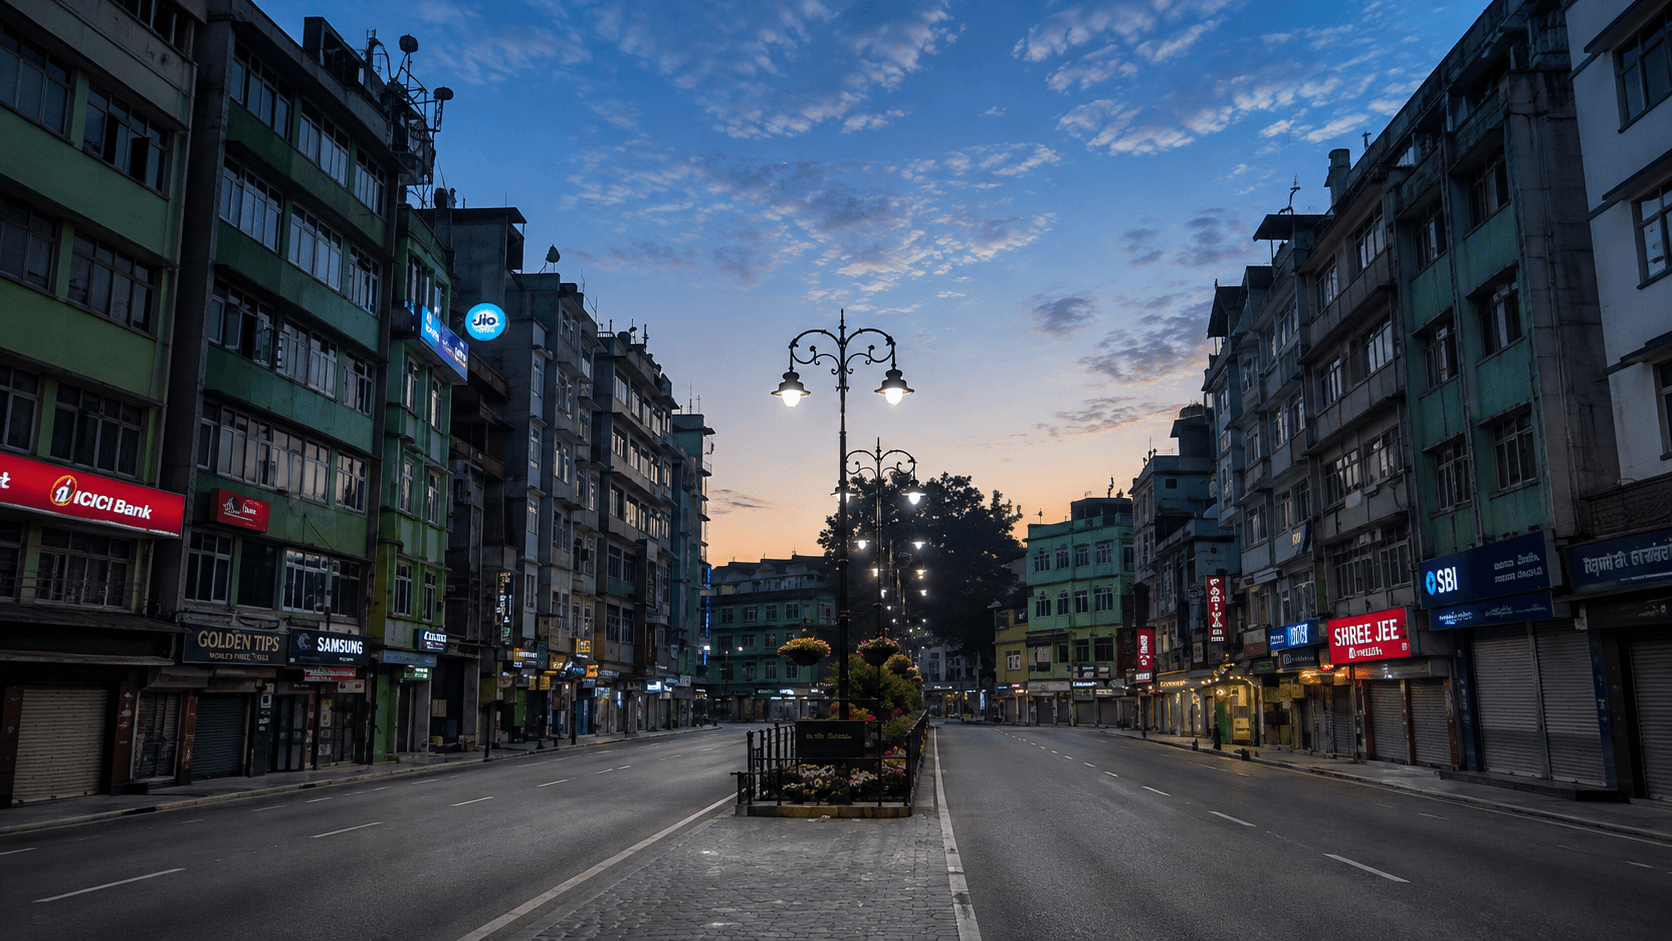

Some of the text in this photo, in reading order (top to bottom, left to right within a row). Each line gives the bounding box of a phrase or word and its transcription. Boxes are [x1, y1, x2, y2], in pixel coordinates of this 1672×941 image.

[472, 313, 496, 326] Jio
[73, 490, 114, 511] ICICI
[113, 499, 152, 519] Bank
[1436, 566, 1458, 593] SBI
[198, 630, 280, 652] GOLDEN TIPS
[1334, 623, 1372, 646] SHREE
[1375, 619, 1399, 642] JEE
[317, 636, 363, 654] SAMSUNG
